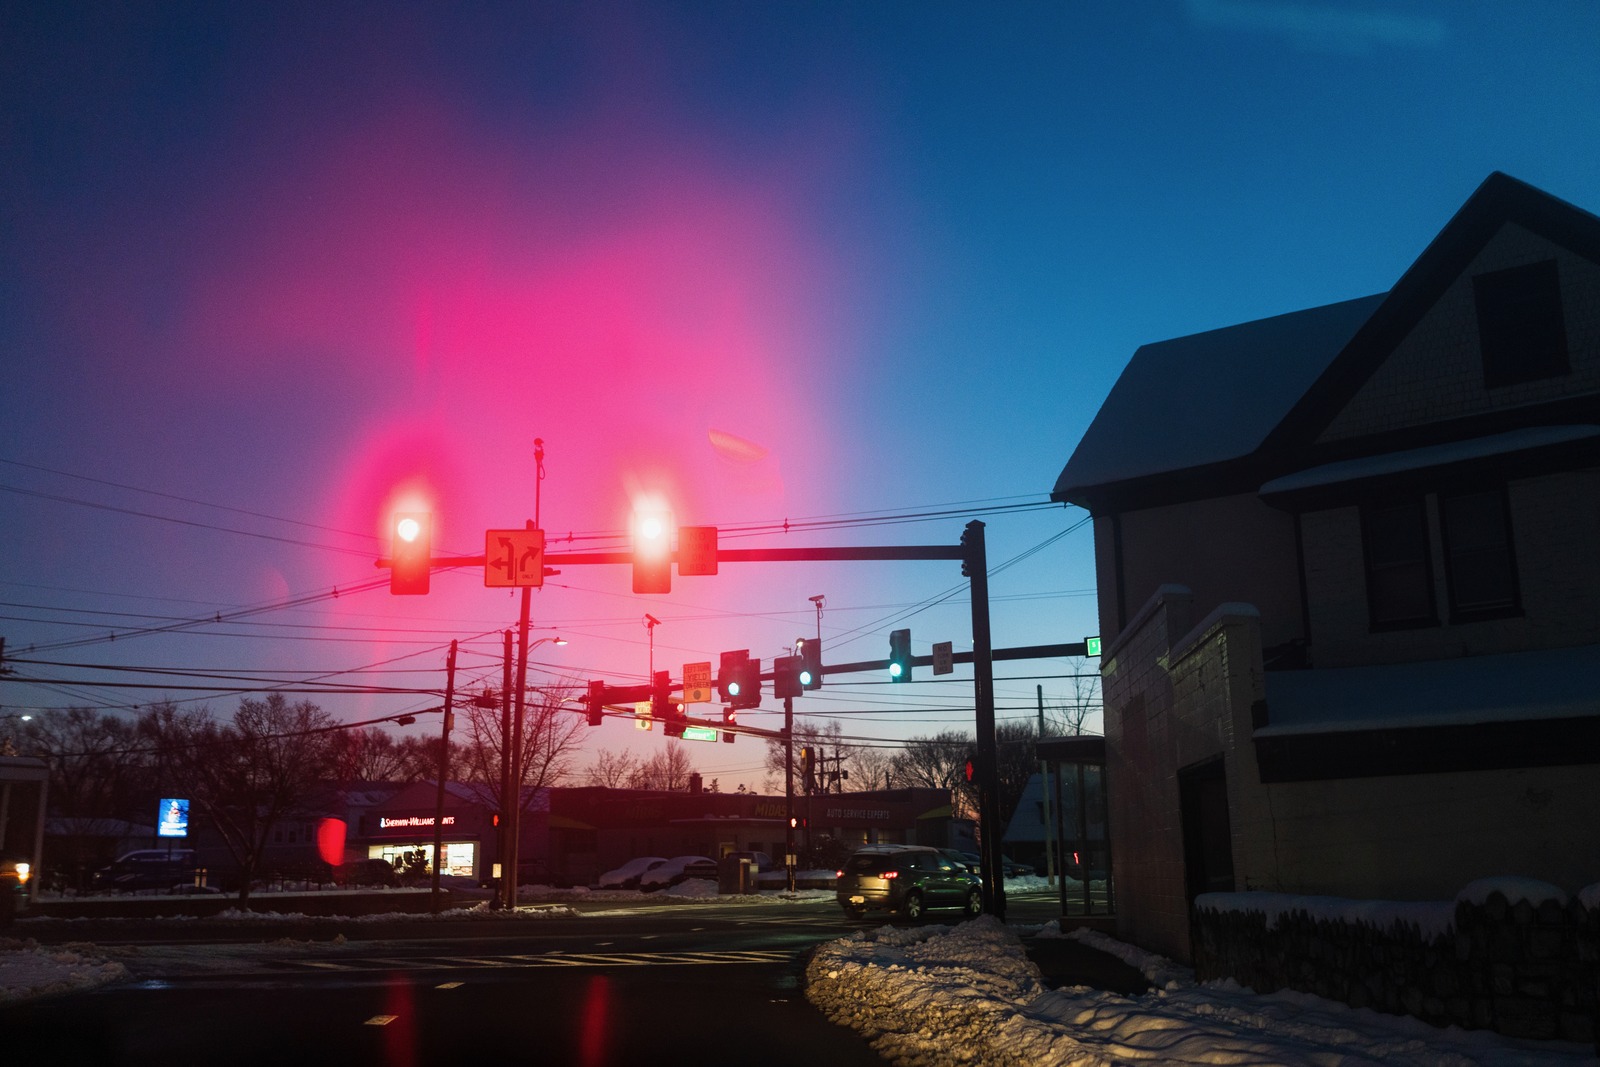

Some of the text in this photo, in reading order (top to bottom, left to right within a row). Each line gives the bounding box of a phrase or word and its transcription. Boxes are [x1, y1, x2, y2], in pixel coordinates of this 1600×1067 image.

[687, 672, 707, 682] YIELD
[755, 804, 787, 817] MIDAS
[826, 808, 890, 820] AUTO SERVICE EXPERTS
